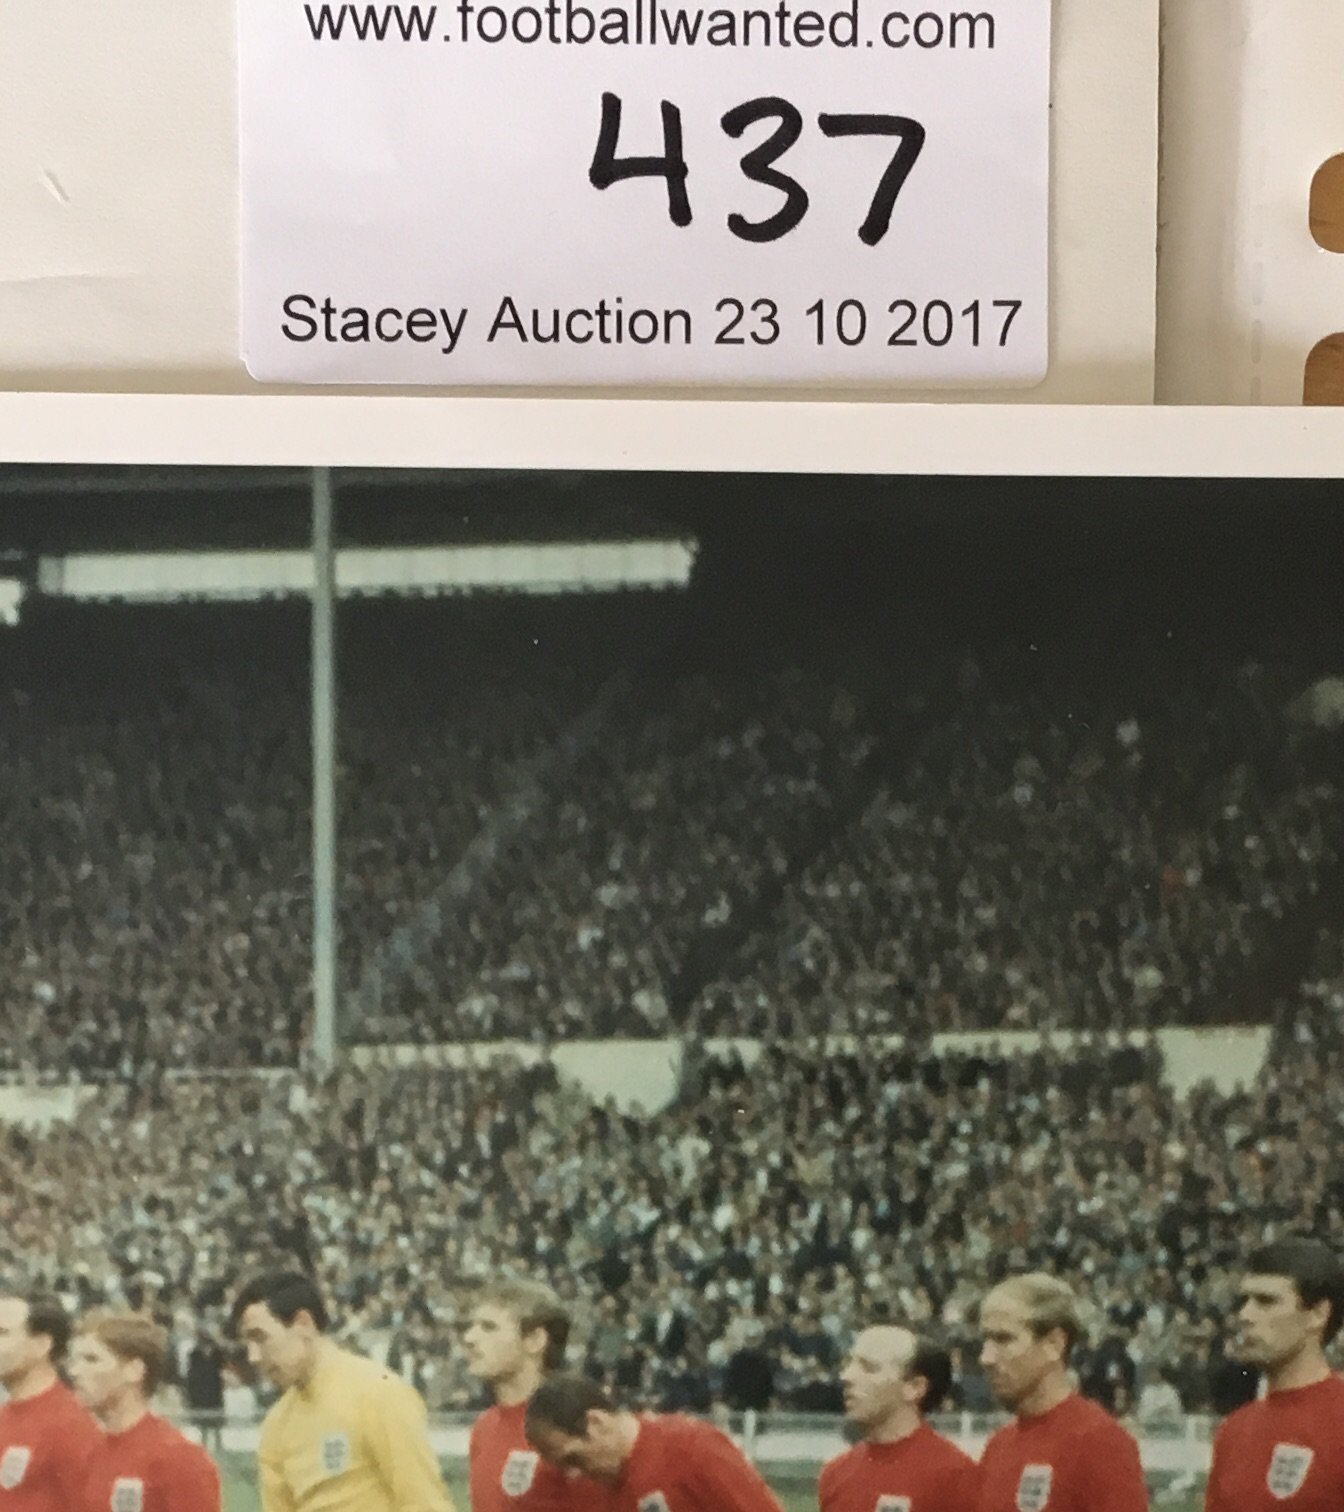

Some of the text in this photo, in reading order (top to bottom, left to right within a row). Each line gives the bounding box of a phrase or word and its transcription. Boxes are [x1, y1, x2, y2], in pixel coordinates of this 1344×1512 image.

[305, 0, 994, 48] www.footballwanted.com
[589, 92, 925, 246] 437
[282, 295, 1022, 354] Stacey Auction 23 10 2017
